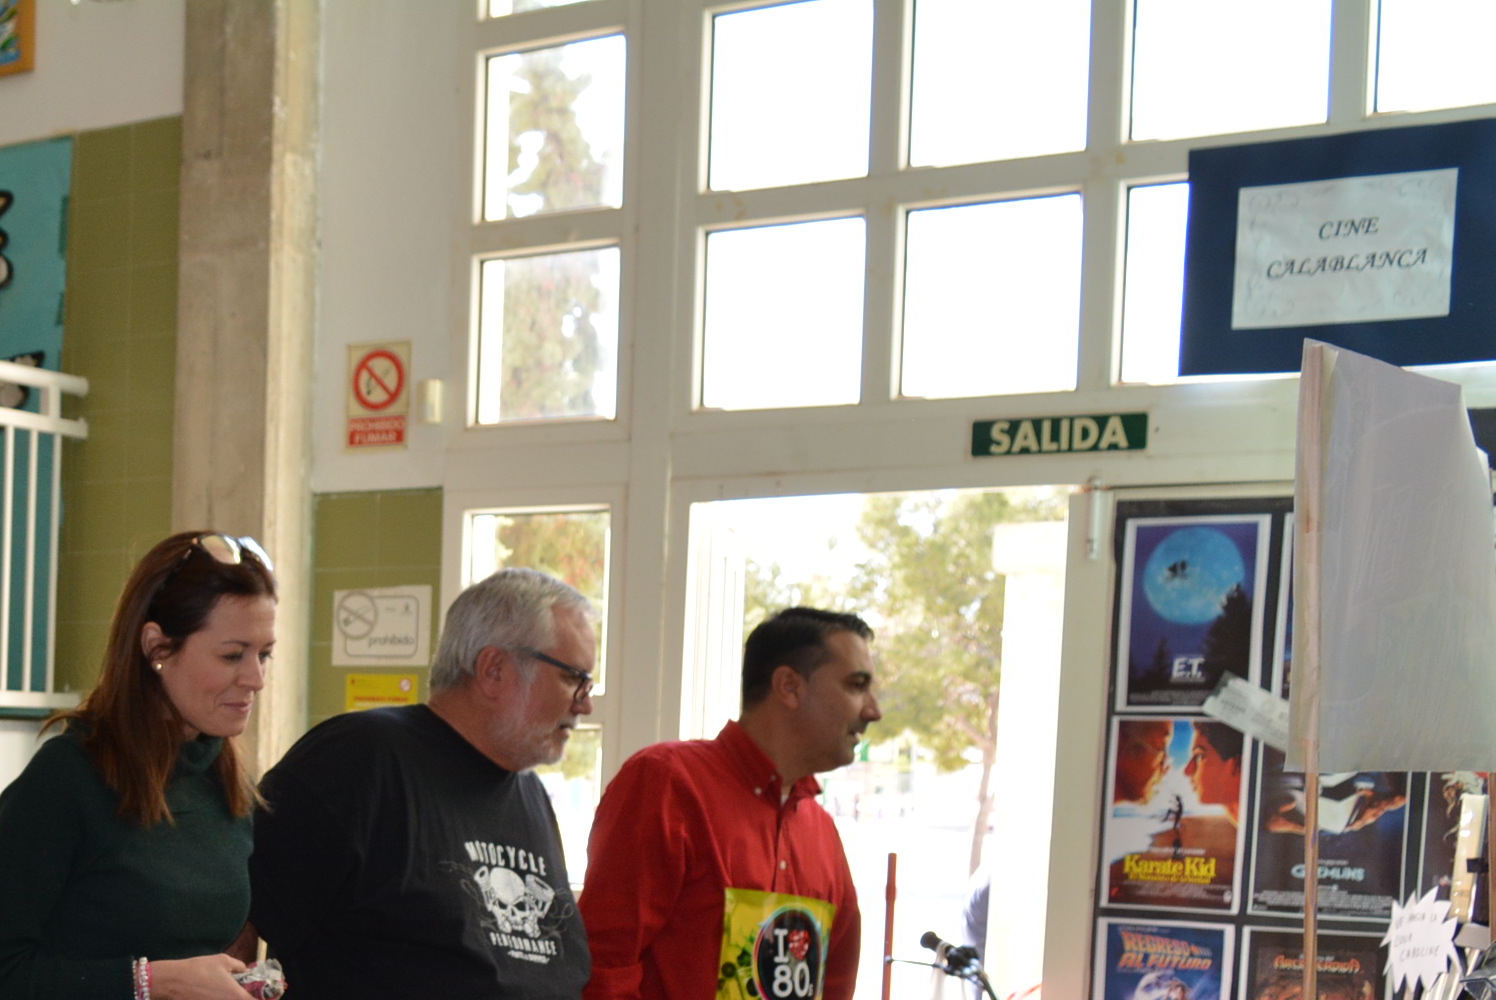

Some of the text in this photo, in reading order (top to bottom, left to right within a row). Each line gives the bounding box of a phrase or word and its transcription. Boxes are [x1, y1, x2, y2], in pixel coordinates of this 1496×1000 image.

[1318, 216, 1380, 242] CINE
[1266, 247, 1430, 281] CALABLANCA
[354, 430, 398, 443] FUMAR
[988, 415, 1130, 455] SALIDA
[1123, 853, 1217, 877] Karate Kid
[773, 928, 790, 963] I
[1121, 930, 1191, 957] REGRESO
[1118, 952, 1145, 969] AL
[1147, 954, 1213, 971] FUTURO
